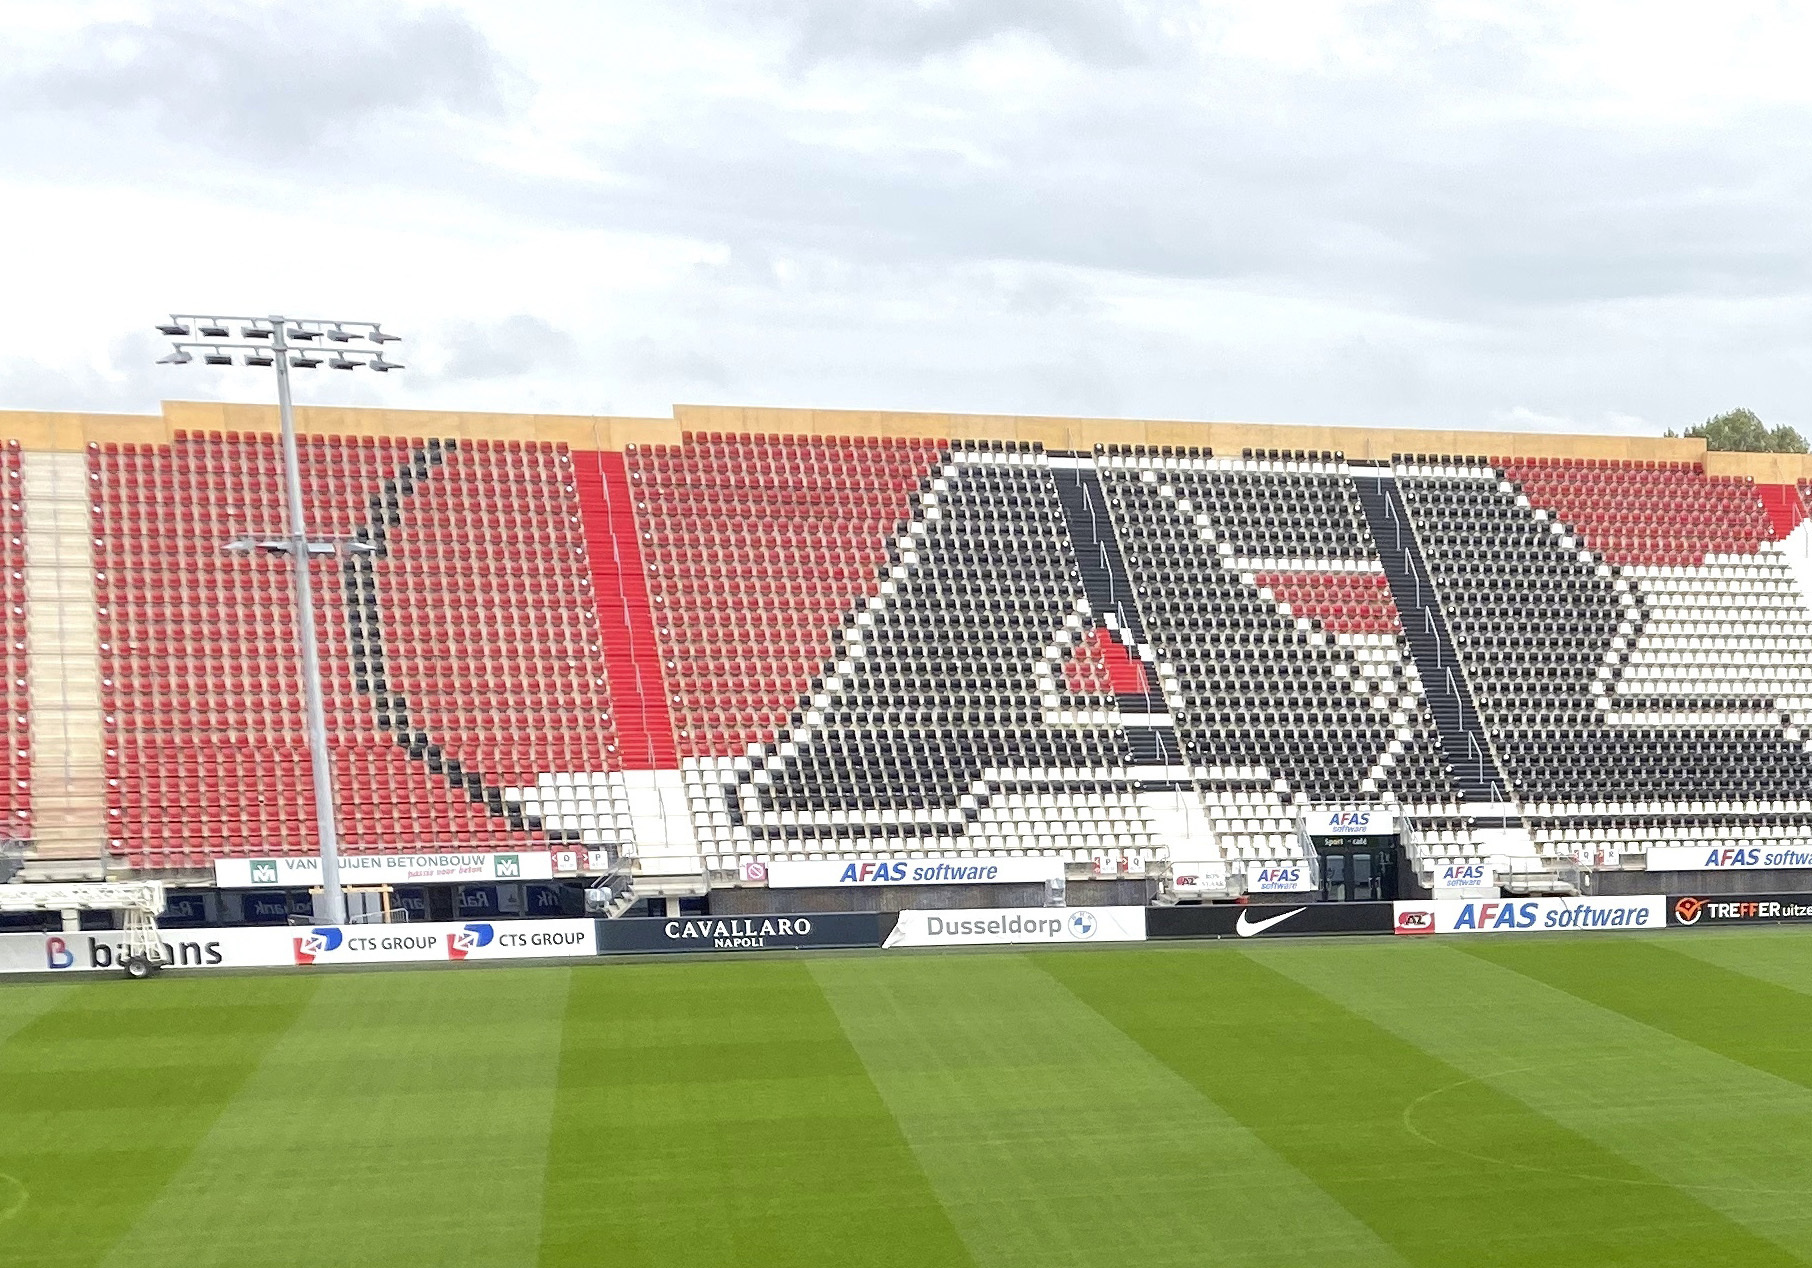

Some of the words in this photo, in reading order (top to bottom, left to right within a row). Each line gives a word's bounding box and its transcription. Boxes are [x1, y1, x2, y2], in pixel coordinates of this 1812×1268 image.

[1329, 812, 1371, 825] AFAS
[1332, 825, 1367, 833] software
[1325, 837, 1344, 846] Sport
[285, 858, 318, 869] VAN
[338, 857, 381, 869] UIJEN
[387, 855, 486, 868] BETONBOUW
[1704, 848, 1761, 866] AFAS
[839, 862, 907, 882] AFAS
[912, 863, 998, 881] software
[1257, 868, 1300, 882] AFAS
[1443, 865, 1484, 879] AFAS
[1260, 882, 1298, 890] software
[1446, 878, 1482, 887] software
[1453, 902, 1539, 929] AFAS
[1544, 905, 1650, 928] software
[1707, 901, 1781, 918] TREFFER
[927, 914, 1062, 937] Dusseldorp
[1405, 914, 1426, 926] AZ
[664, 917, 812, 939] CAVALLARO
[347, 937, 377, 951] CTS
[381, 936, 437, 950] GROUP
[499, 933, 527, 947] CTS
[532, 932, 585, 946] GROUP
[714, 937, 764, 948] NAPOLI
